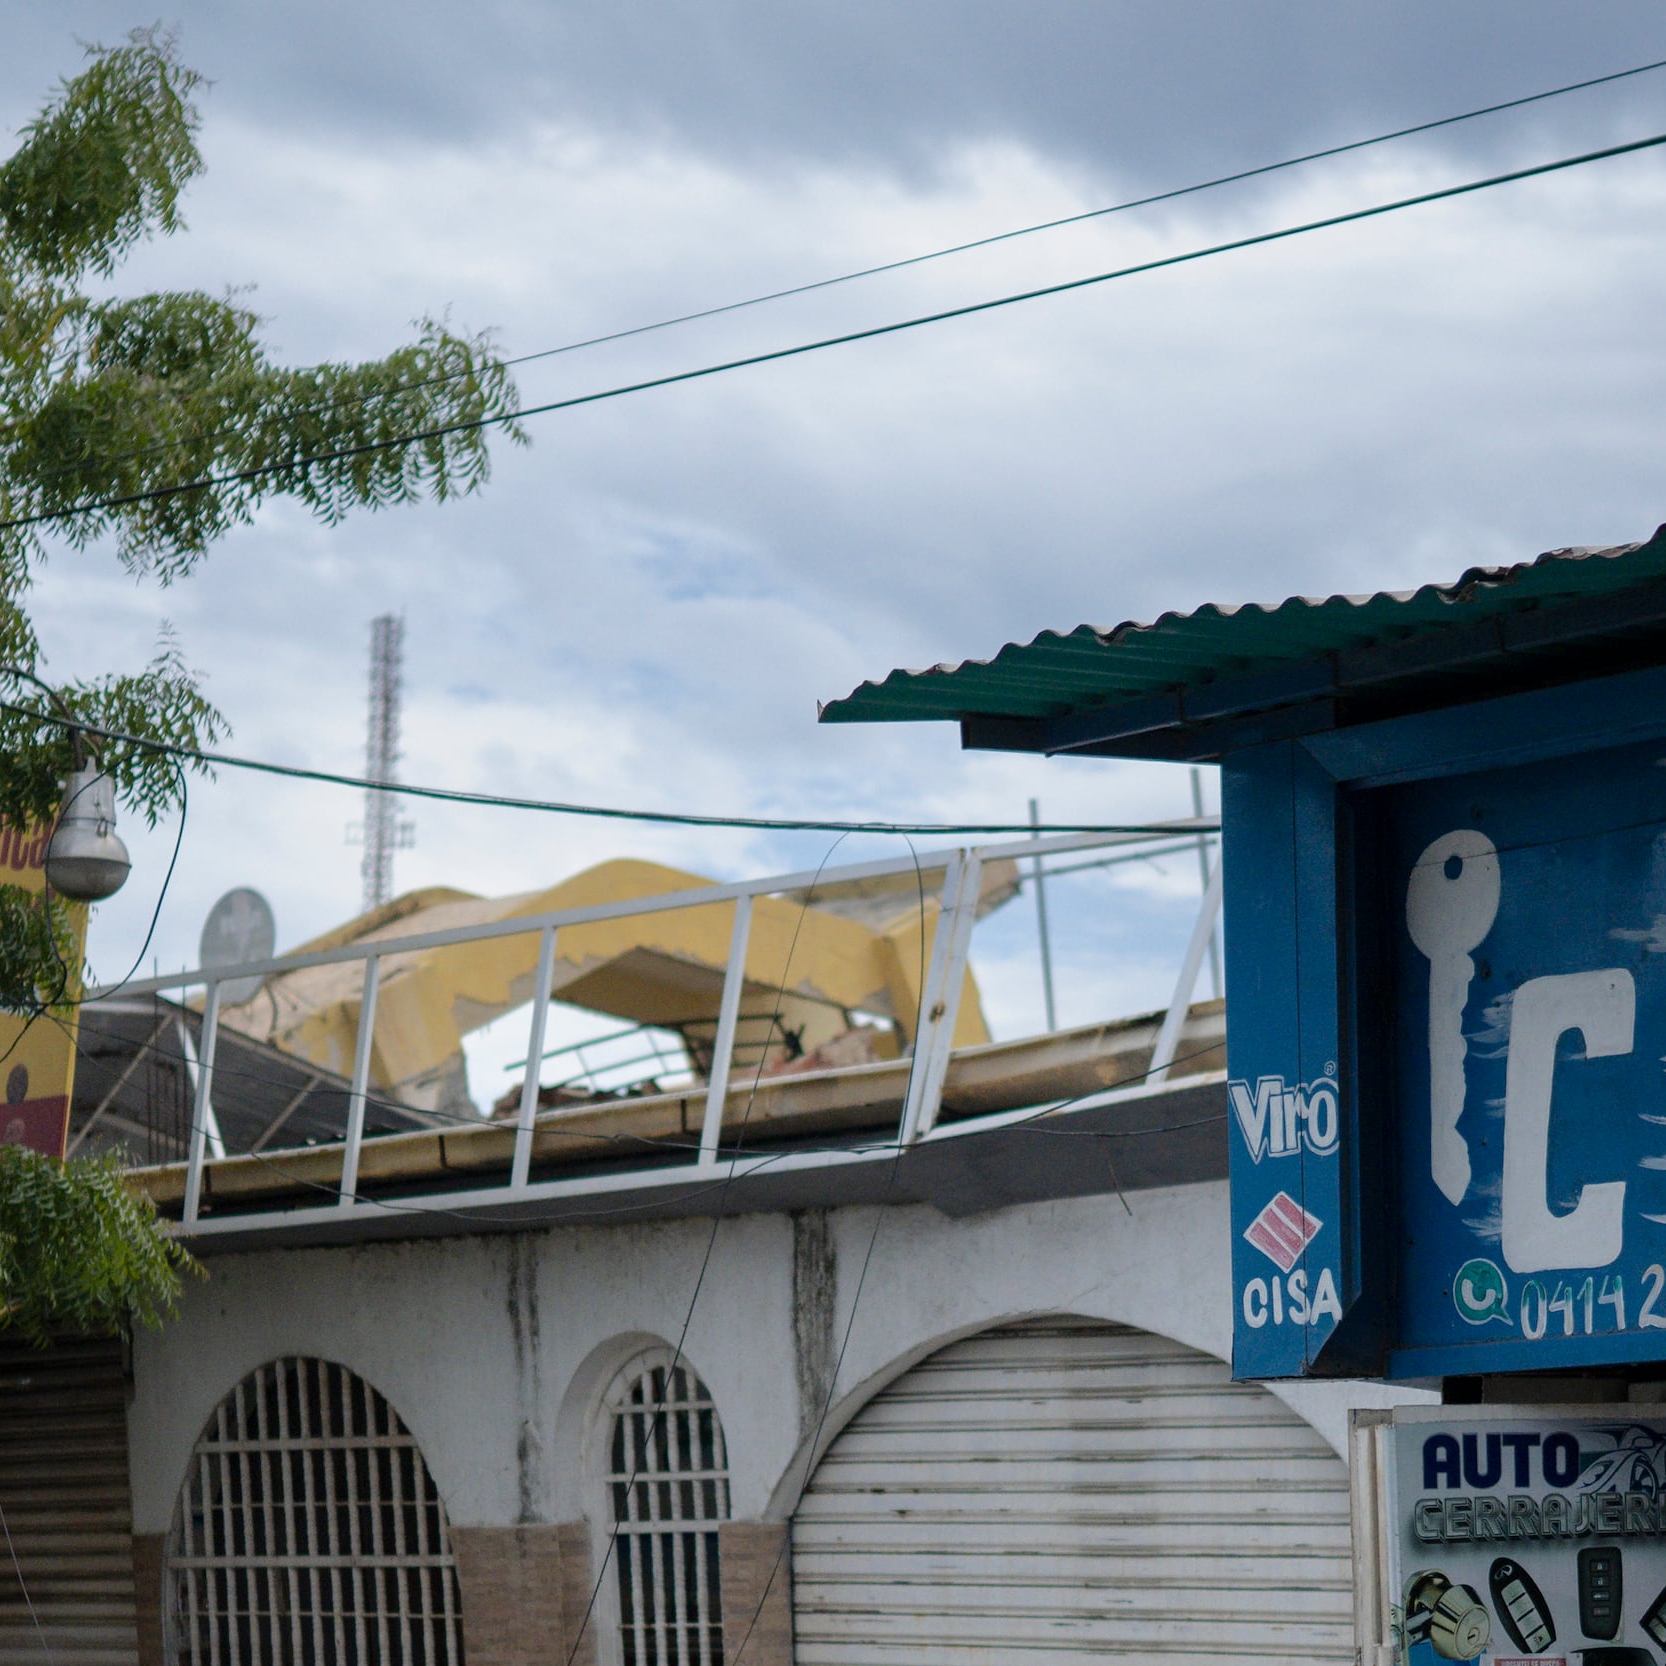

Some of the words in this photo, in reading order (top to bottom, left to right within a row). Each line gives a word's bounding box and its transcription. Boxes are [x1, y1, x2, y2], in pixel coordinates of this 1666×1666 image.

[1243, 1267, 1343, 1329] CISA
[1520, 1275, 1627, 1340] 0414
[1423, 1432, 1580, 1490] AUTO
